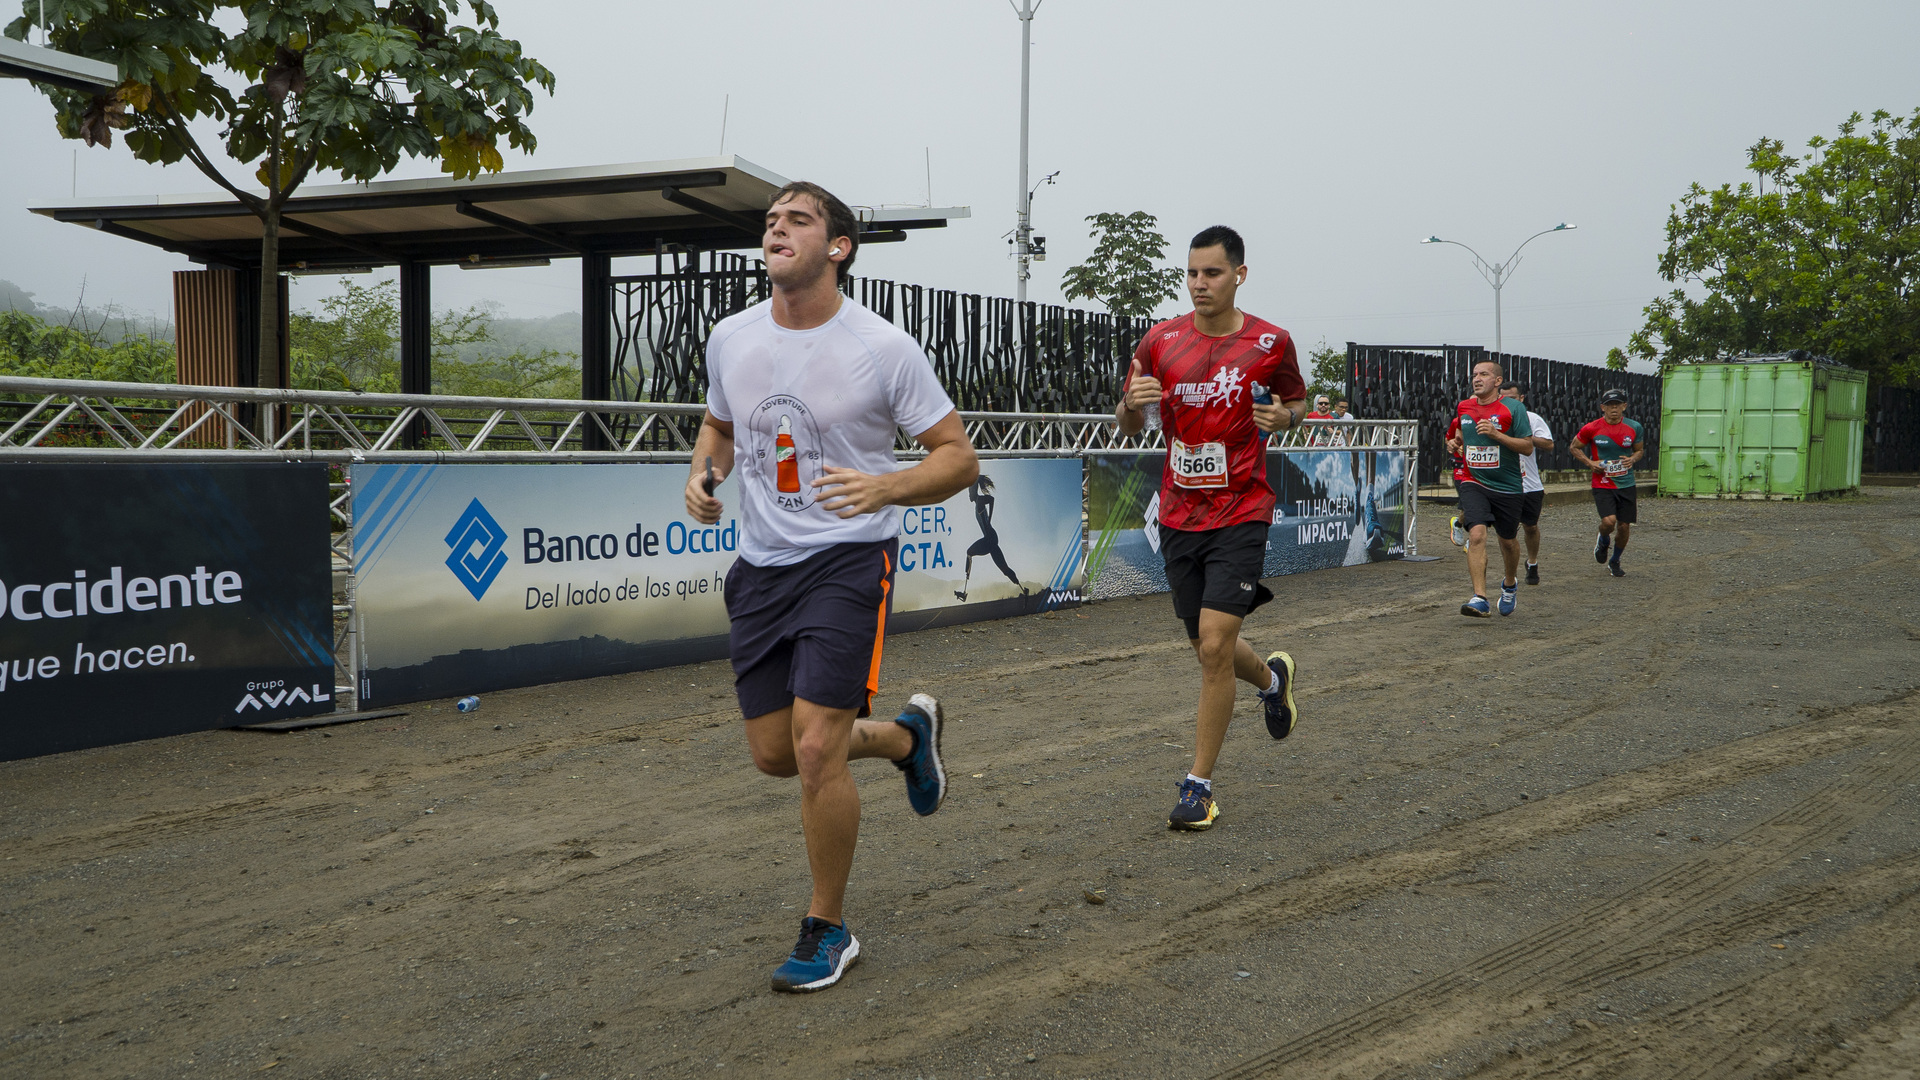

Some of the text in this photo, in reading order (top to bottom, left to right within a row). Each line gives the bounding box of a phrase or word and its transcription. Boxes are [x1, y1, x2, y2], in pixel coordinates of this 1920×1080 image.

[1174, 382, 1217, 396] ATHLETIC
[761, 398, 808, 416] ADVENTURE
[757, 450, 766, 459] 19
[808, 451, 820, 460] 85
[1471, 452, 1494, 462] 2017
[1177, 455, 1216, 474] 1566
[1609, 464, 1622, 473] 858
[777, 495, 804, 508] FAN
[1296, 499, 1310, 520] TU
[1313, 496, 1351, 518] HACER,
[1297, 520, 1352, 545] IMPACTA.
[523, 518, 741, 565] Banco de Occid
[1387, 544, 1405, 555] AVAL
[0, 565, 243, 621] ccidente
[525, 583, 560, 610] Del
[566, 580, 611, 607] lado
[616, 577, 639, 600] de
[645, 575, 671, 598] los
[676, 577, 709, 601] que
[1047, 590, 1080, 604] AVAL
[73, 642, 196, 674] hacen.
[246, 679, 285, 692] Grupo
[234, 683, 330, 714] AVAL
